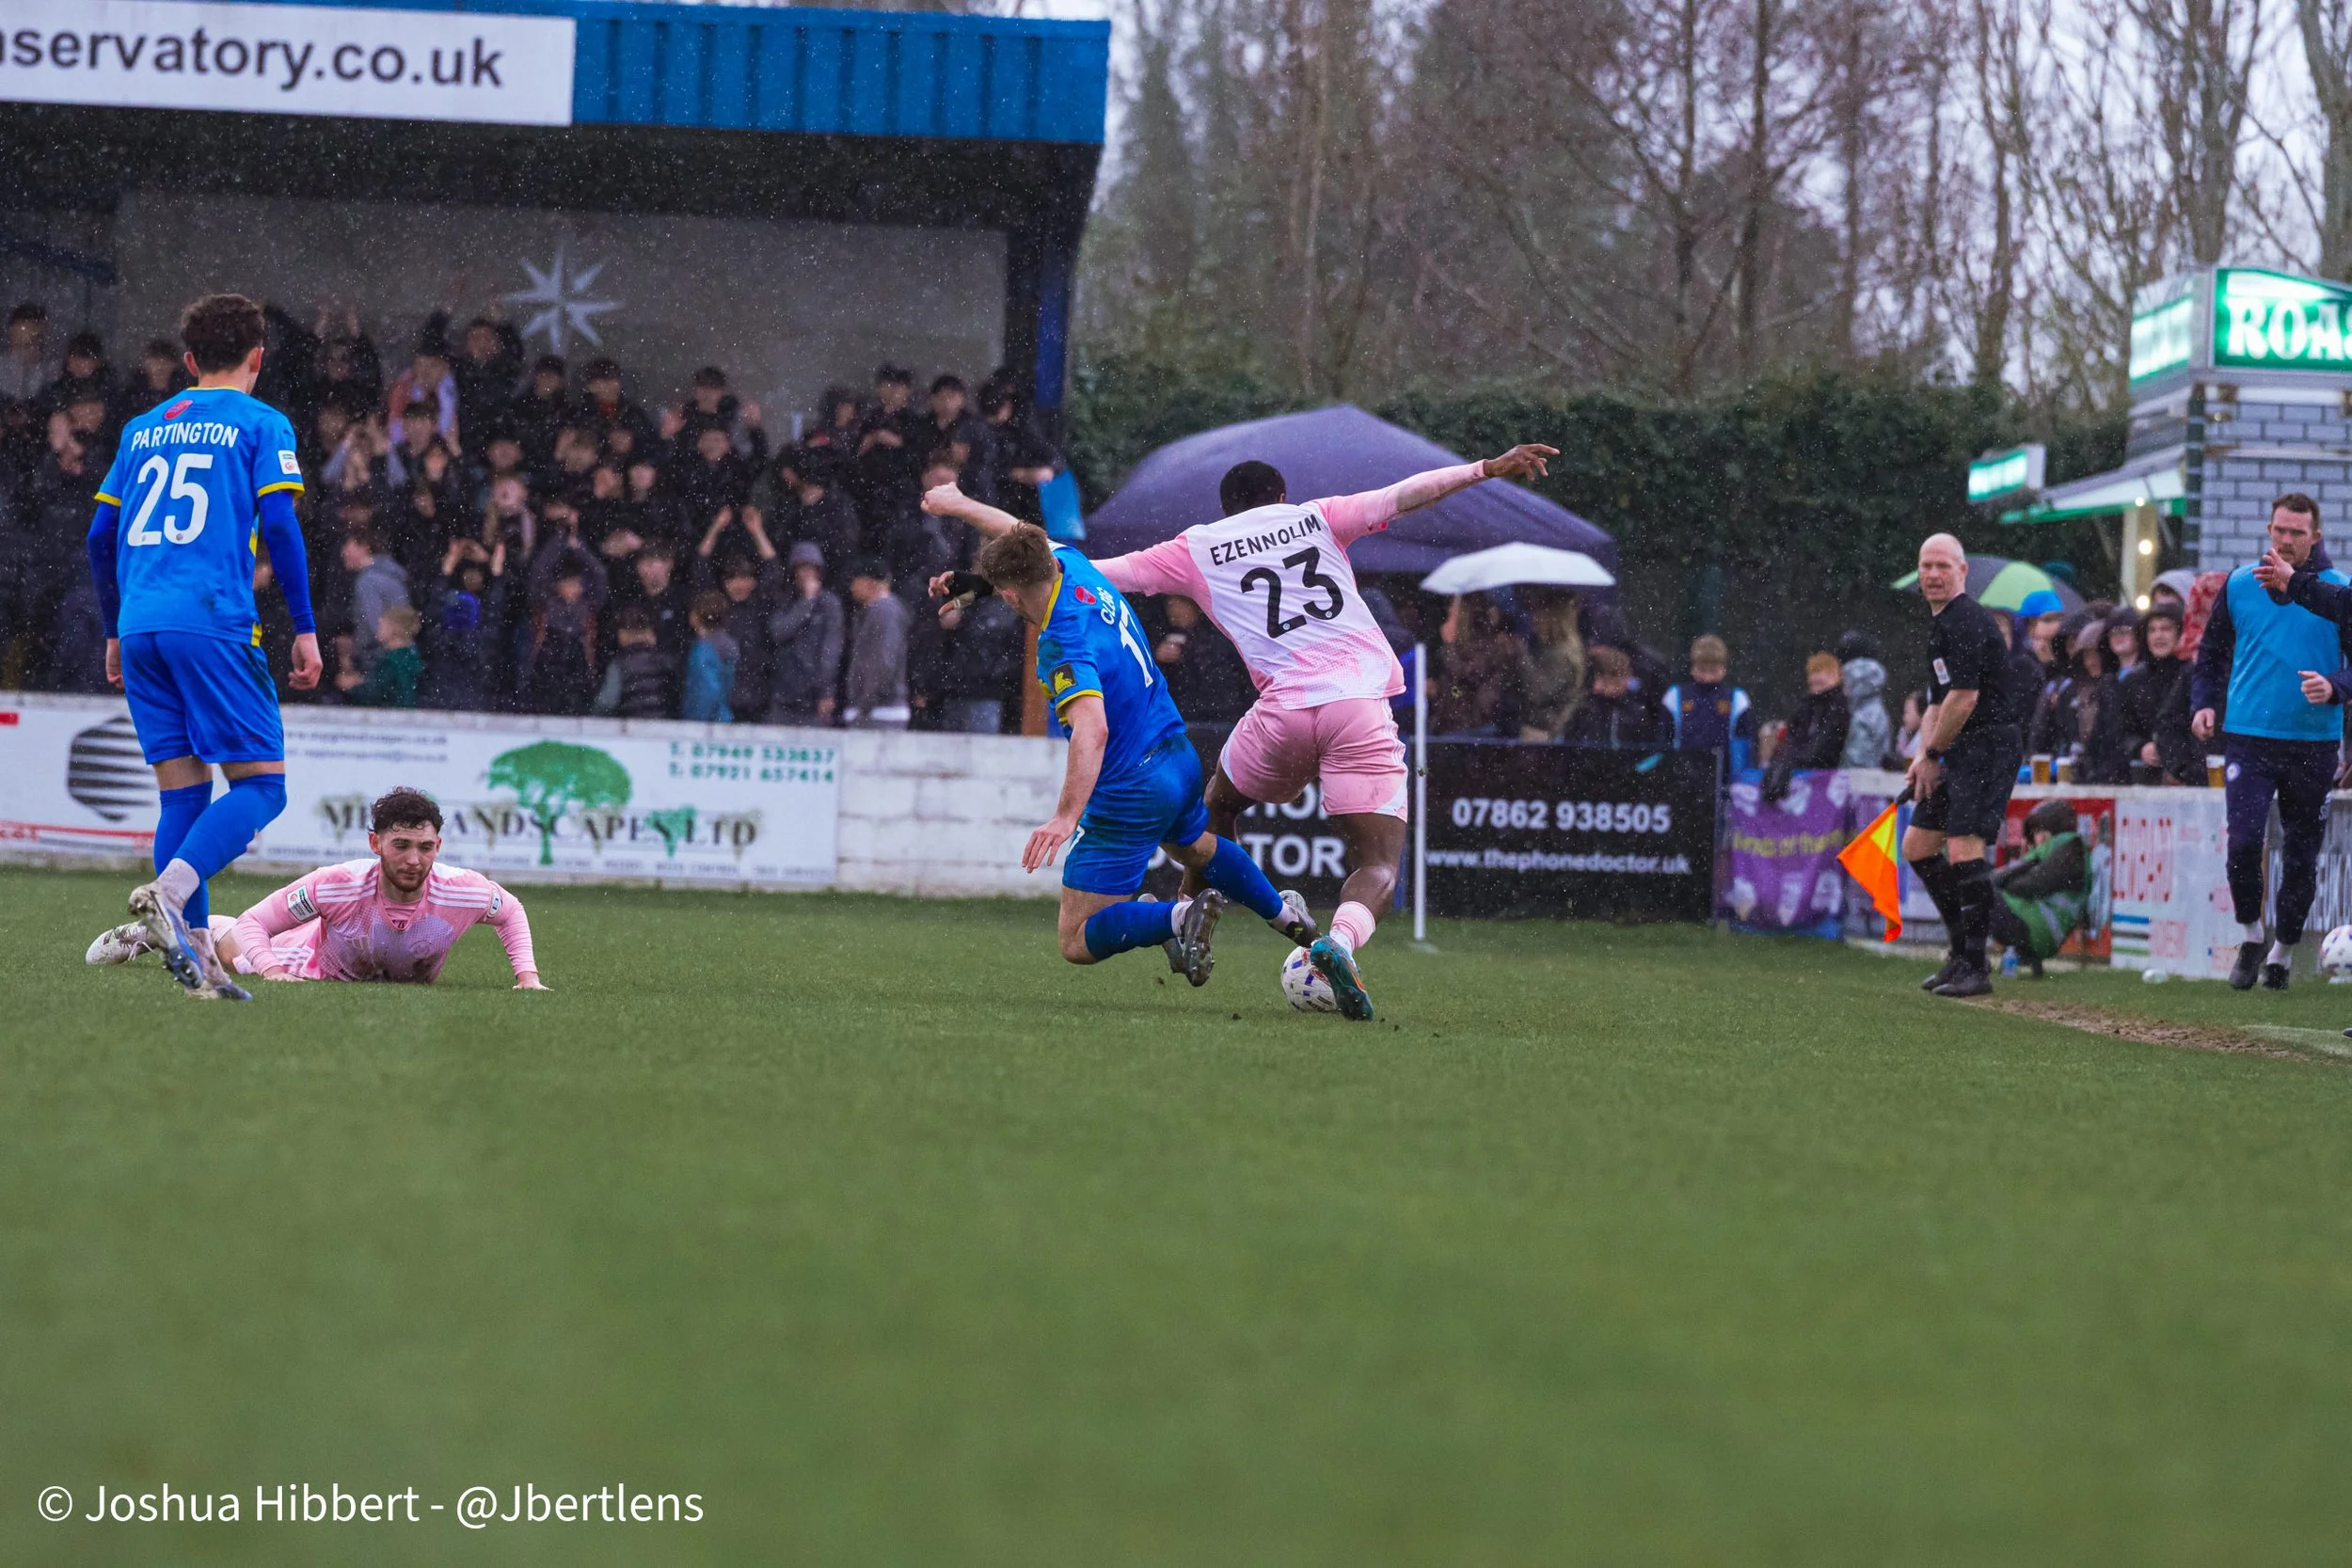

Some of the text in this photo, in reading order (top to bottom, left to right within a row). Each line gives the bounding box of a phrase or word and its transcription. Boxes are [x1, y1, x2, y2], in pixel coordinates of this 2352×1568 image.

[2226, 298, 2352, 360] ROA
[131, 422, 239, 451] PARTINGTON
[127, 452, 214, 546] 25
[1210, 515, 1321, 565] EZENNOLIM
[1240, 546, 1344, 639] 23
[1453, 799, 1672, 833] 07862 938505
